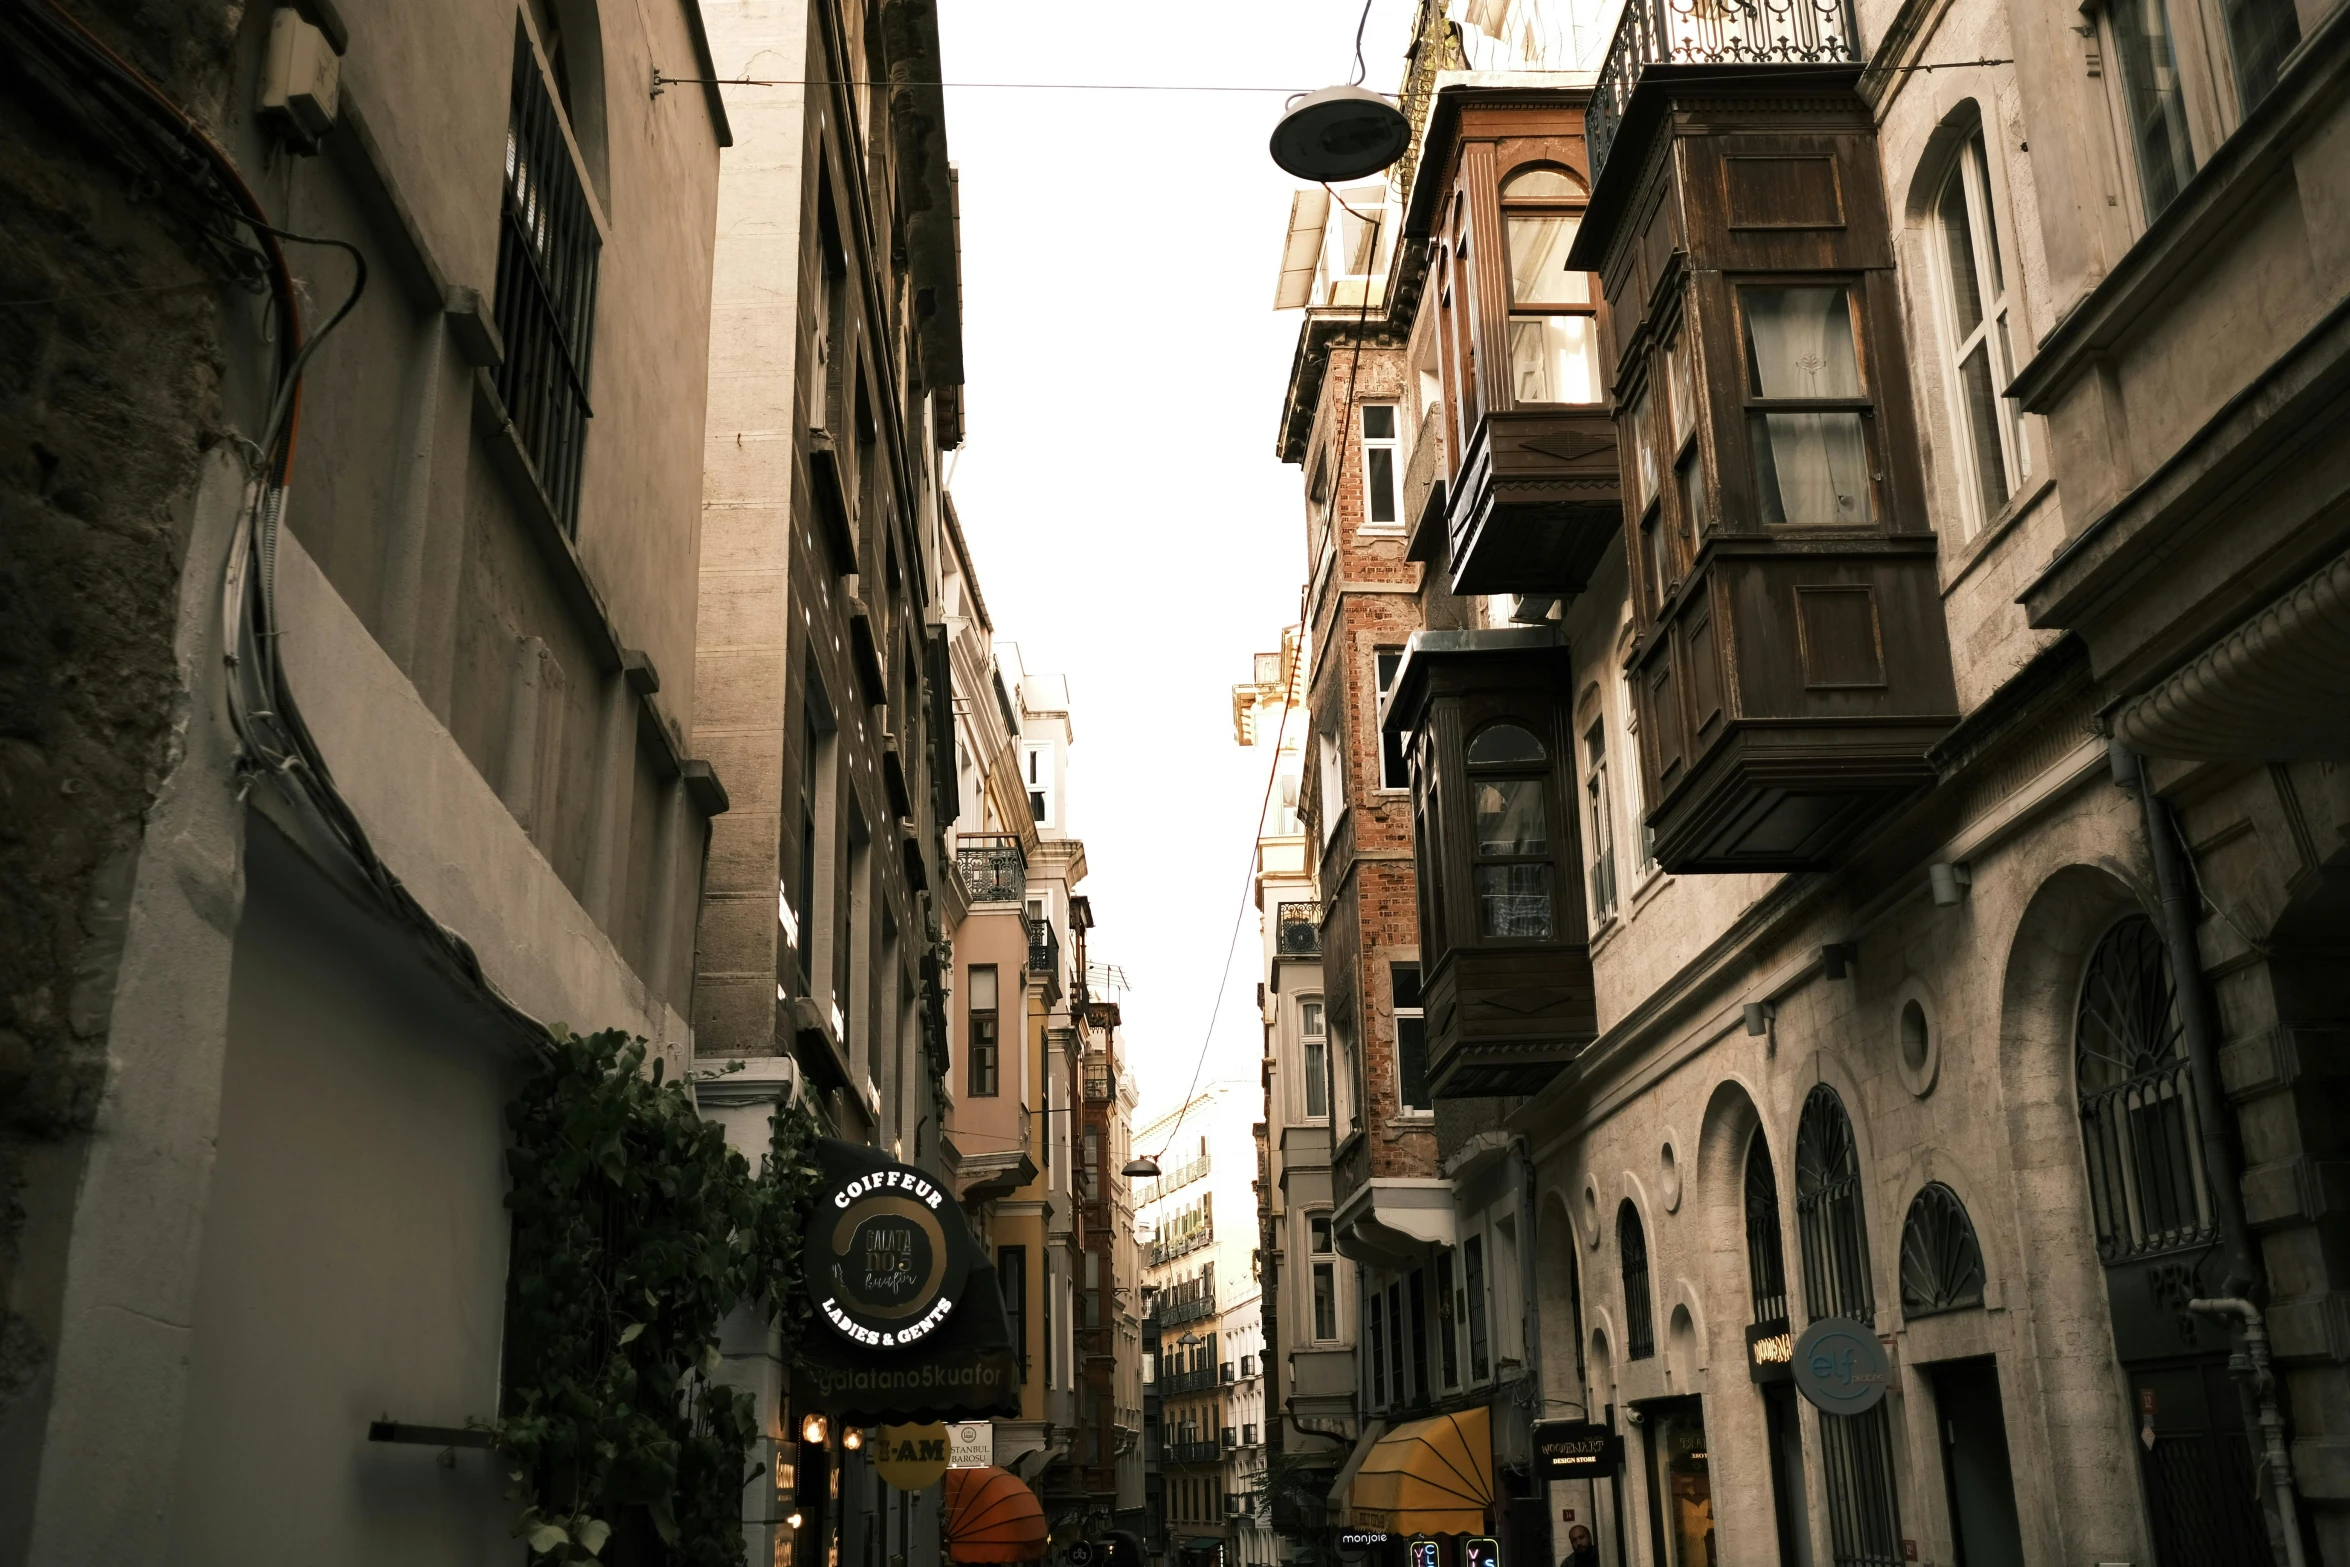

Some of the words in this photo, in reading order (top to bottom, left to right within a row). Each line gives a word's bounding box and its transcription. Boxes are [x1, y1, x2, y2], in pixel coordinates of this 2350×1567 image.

[834, 1171, 943, 1209] COIFFEUR
[866, 1229, 911, 1251] GALATA
[822, 1297, 880, 1346] LADIES
[882, 1333, 895, 1346] &
[897, 1297, 952, 1344] GENTS
[1810, 1347, 1853, 1386] elf
[879, 1439, 945, 1462] I-AM
[950, 1446, 989, 1454] STANBUL
[951, 1455, 986, 1463] BAROSU
[1552, 1457, 1576, 1465] DESIGN
[1342, 1532, 1387, 1545] monjoie
